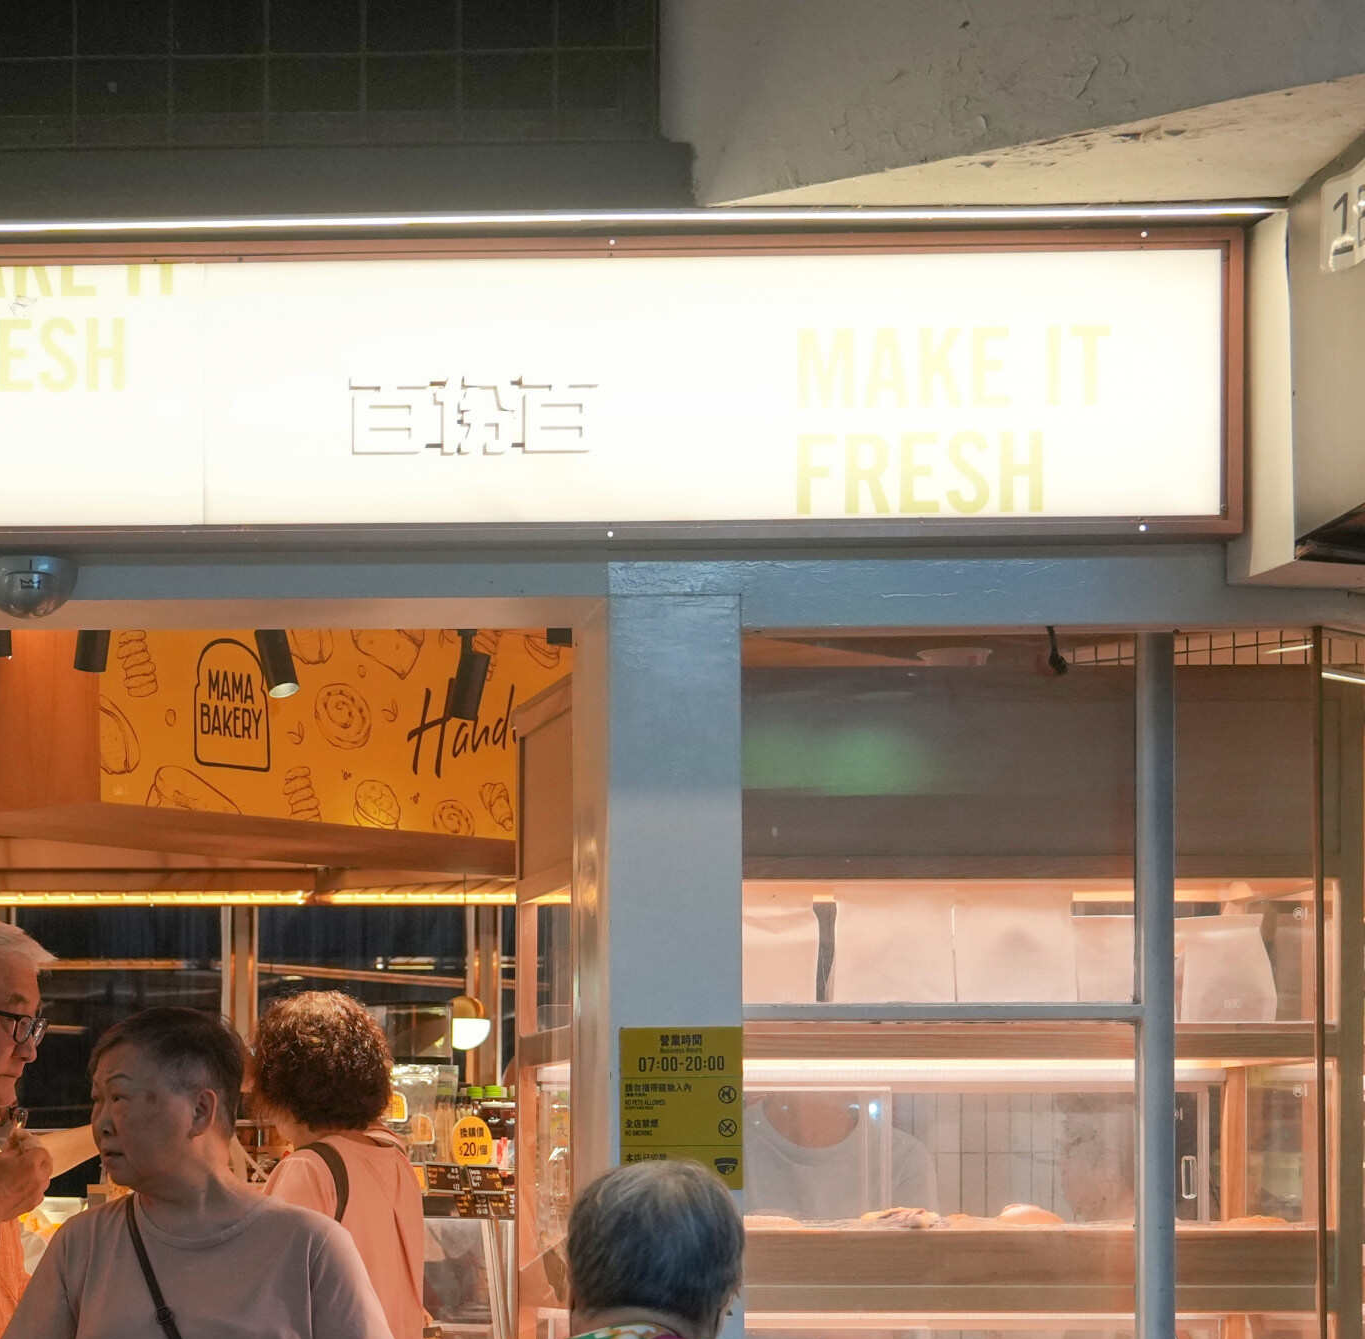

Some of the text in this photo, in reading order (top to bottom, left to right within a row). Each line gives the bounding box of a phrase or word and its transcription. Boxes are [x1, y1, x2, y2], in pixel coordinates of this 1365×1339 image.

[795, 324, 1112, 407] MAKE IT
[795, 430, 1045, 514] FRESH
[206, 667, 255, 706] MAMA
[199, 703, 263, 741] BAKERY
[407, 684, 517, 778] Hand
[660, 1034, 702, 1047] 營業時間
[638, 1056, 725, 1072] 07:00-20:00
